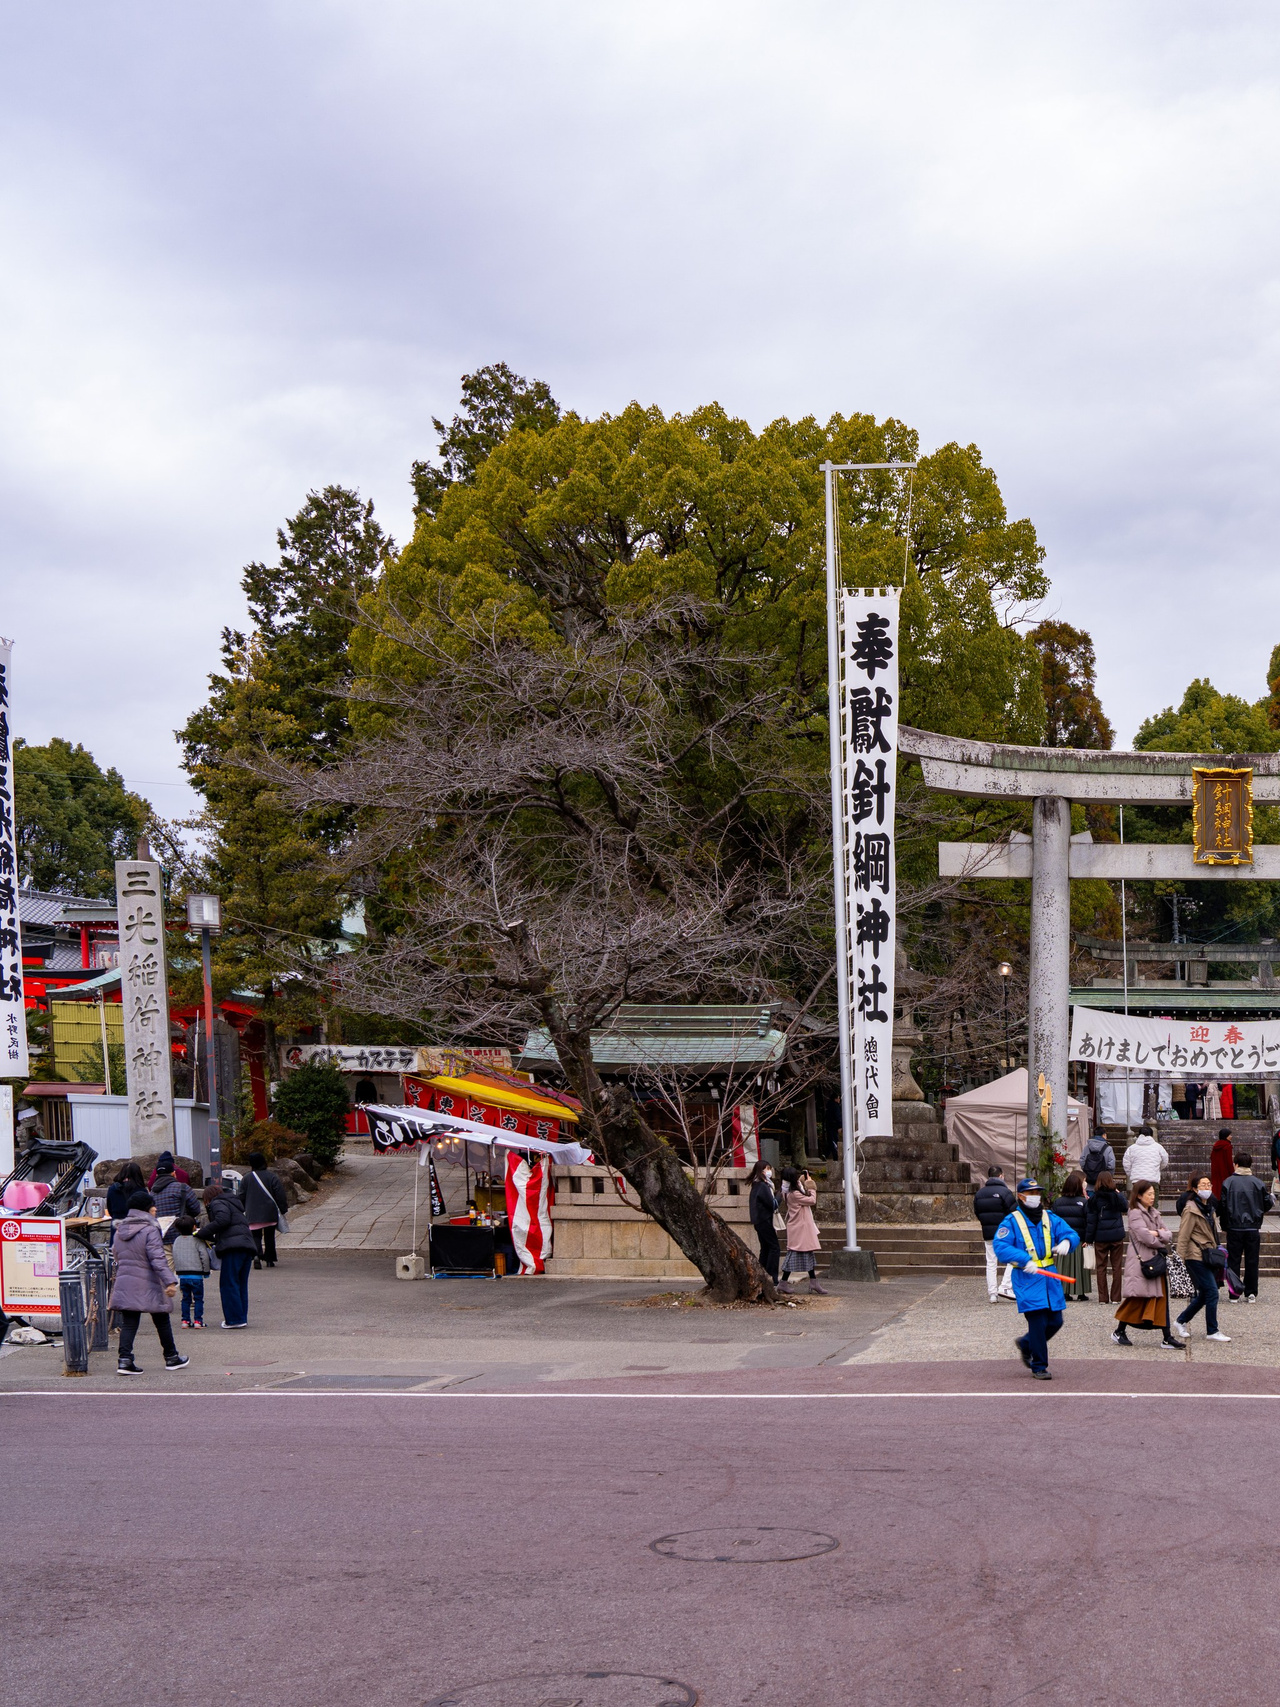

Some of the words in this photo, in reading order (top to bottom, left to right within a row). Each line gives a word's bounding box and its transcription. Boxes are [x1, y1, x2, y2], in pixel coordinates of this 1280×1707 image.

[1213, 783, 1232, 849] 針綱神社
[122, 870, 168, 1122] 三光稲荷神社
[1189, 1024, 1245, 1045] 迎春
